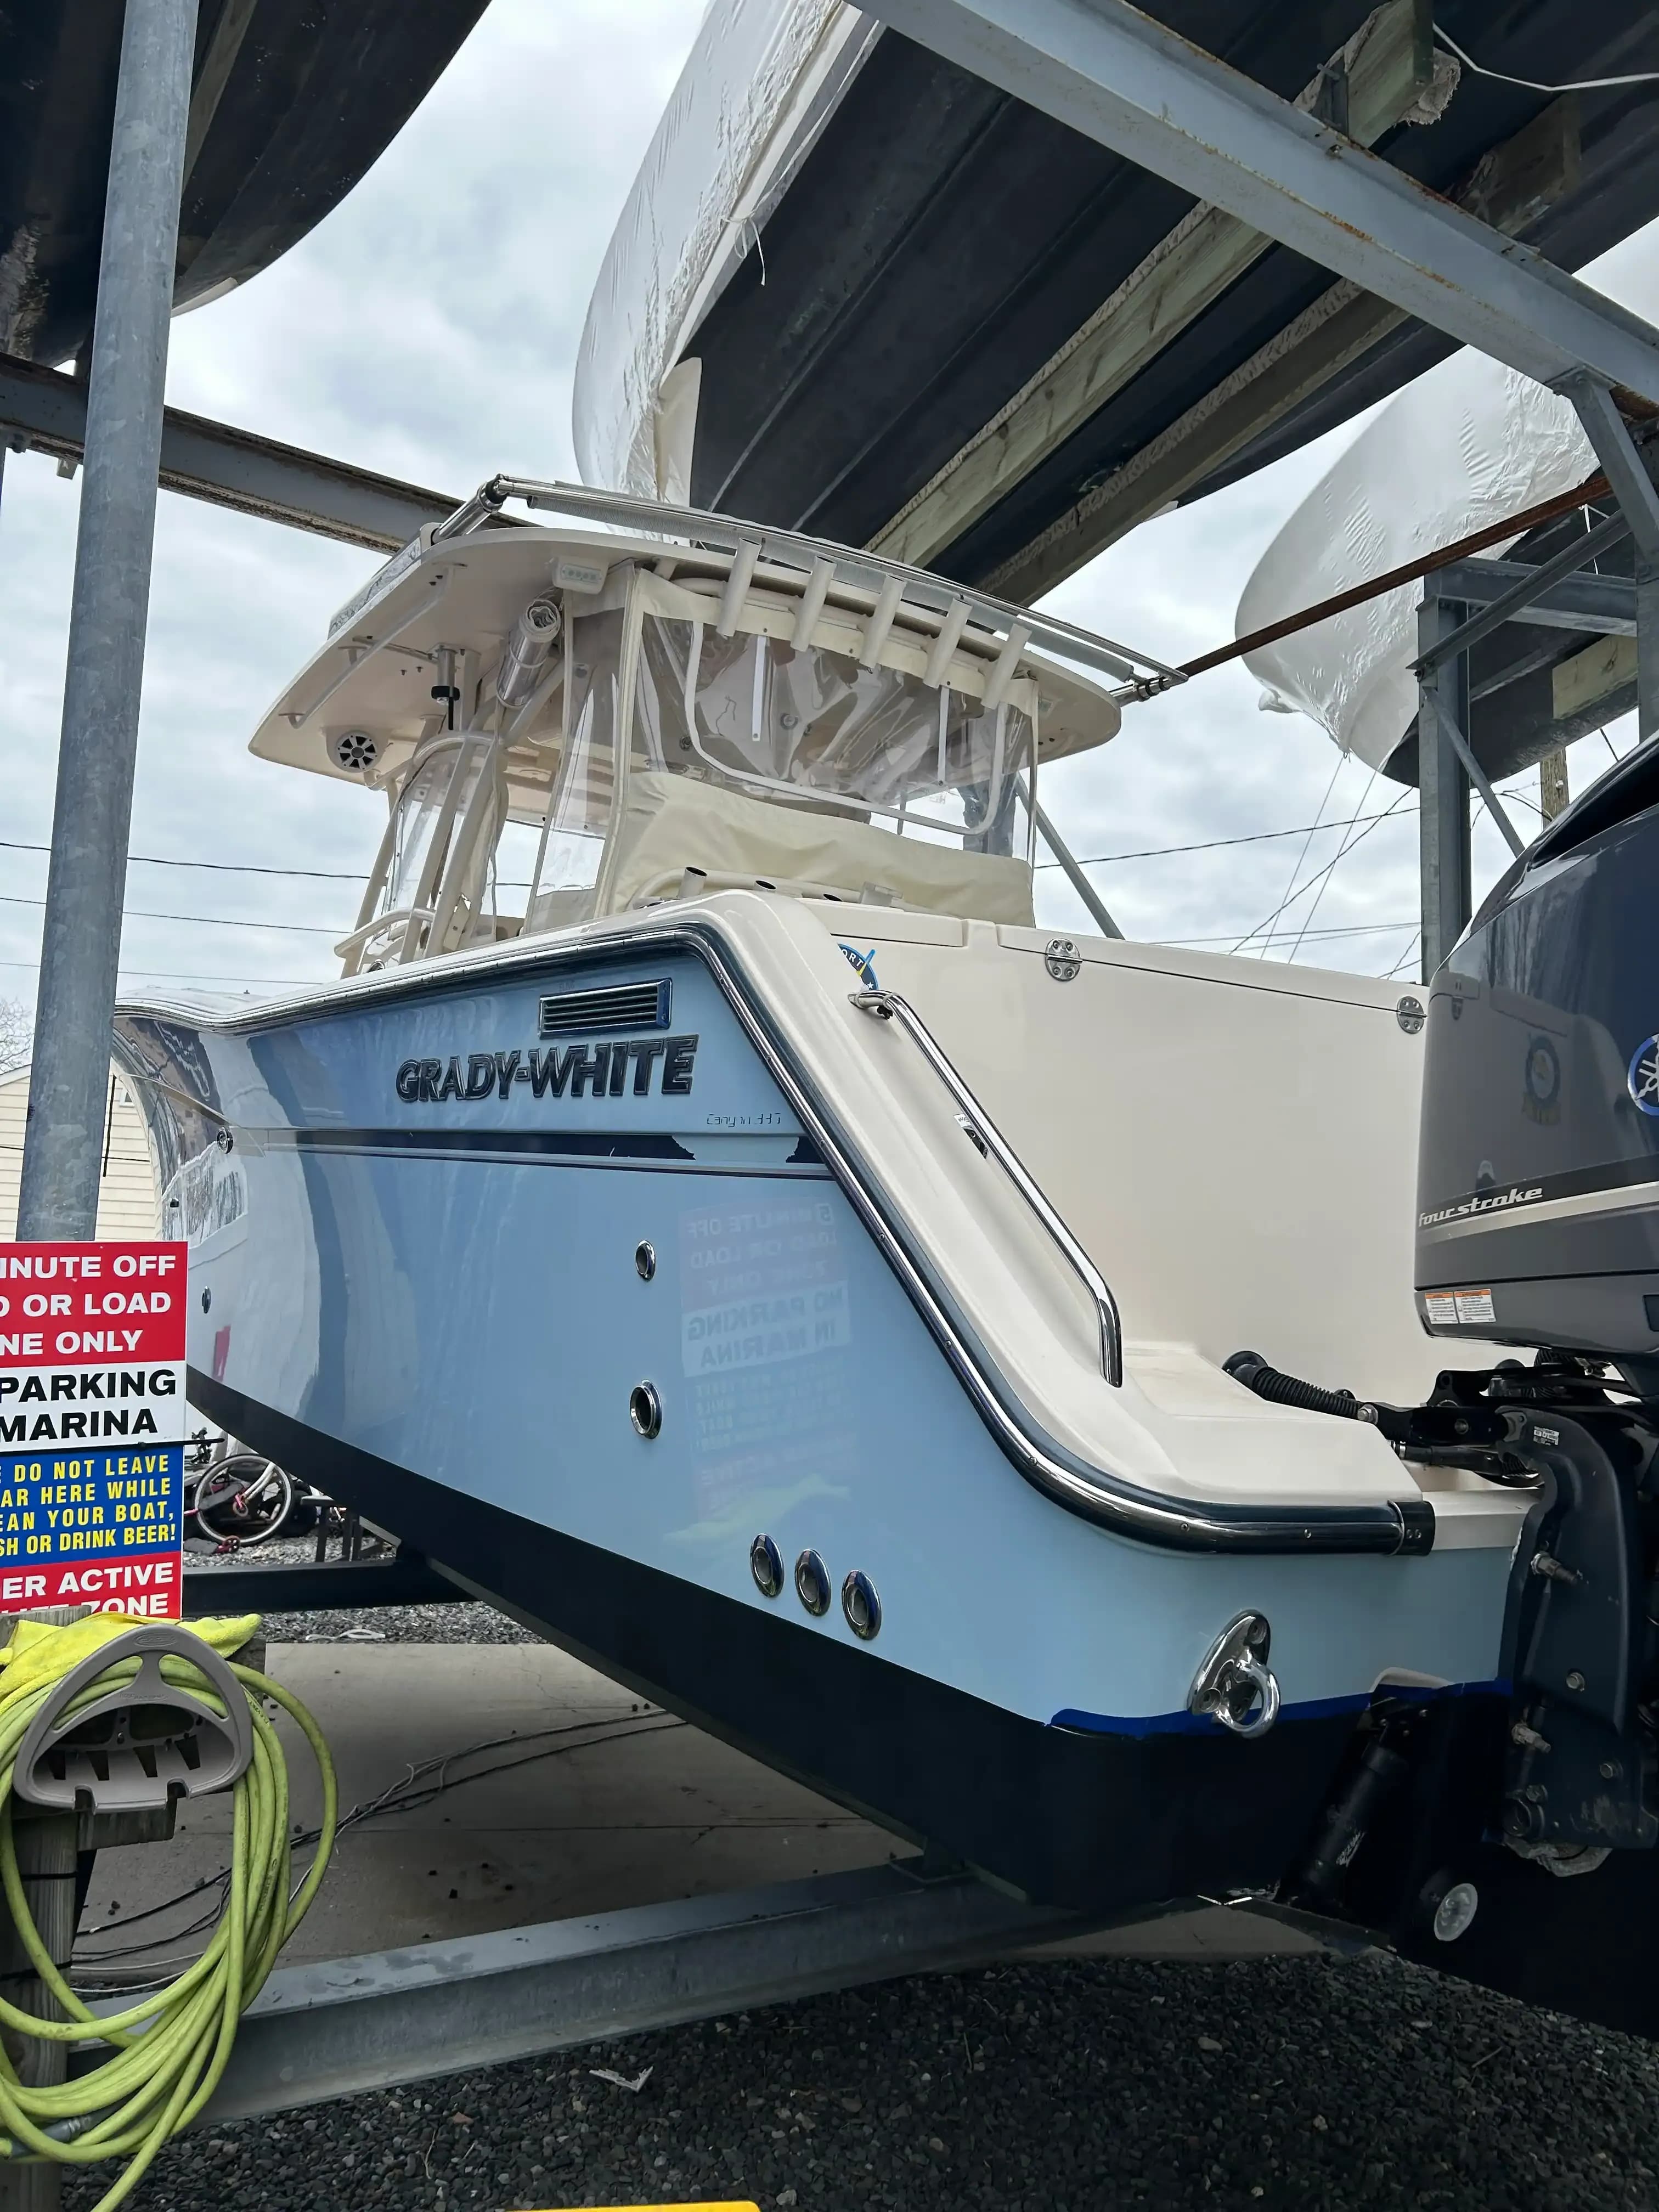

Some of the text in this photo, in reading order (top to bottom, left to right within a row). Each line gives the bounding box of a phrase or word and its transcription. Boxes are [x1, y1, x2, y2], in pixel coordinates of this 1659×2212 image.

[396, 1034, 699, 1103] GRADY-WHITE
[113, 1255, 176, 1277] OFF
[22, 1294, 72, 1317] OR
[84, 1292, 171, 1315] LOAD
[55, 1329, 143, 1354] ONLY
[0, 1369, 176, 1403] PARKING
[0, 1408, 158, 1442] MARINA
[14, 1463, 41, 1482] DO
[54, 1459, 95, 1479] NOT
[105, 1455, 168, 1476] LEAVE
[41, 1484, 95, 1504] HERE
[108, 1478, 171, 1500] WHILE
[47, 1507, 104, 1527] YOUR
[115, 1500, 173, 1522] BOAT,
[26, 1534, 52, 1554] OR
[59, 1530, 115, 1551] DRINK
[123, 1524, 176, 1545] BEER!
[2, 1562, 173, 1600] ER ACTIVE
